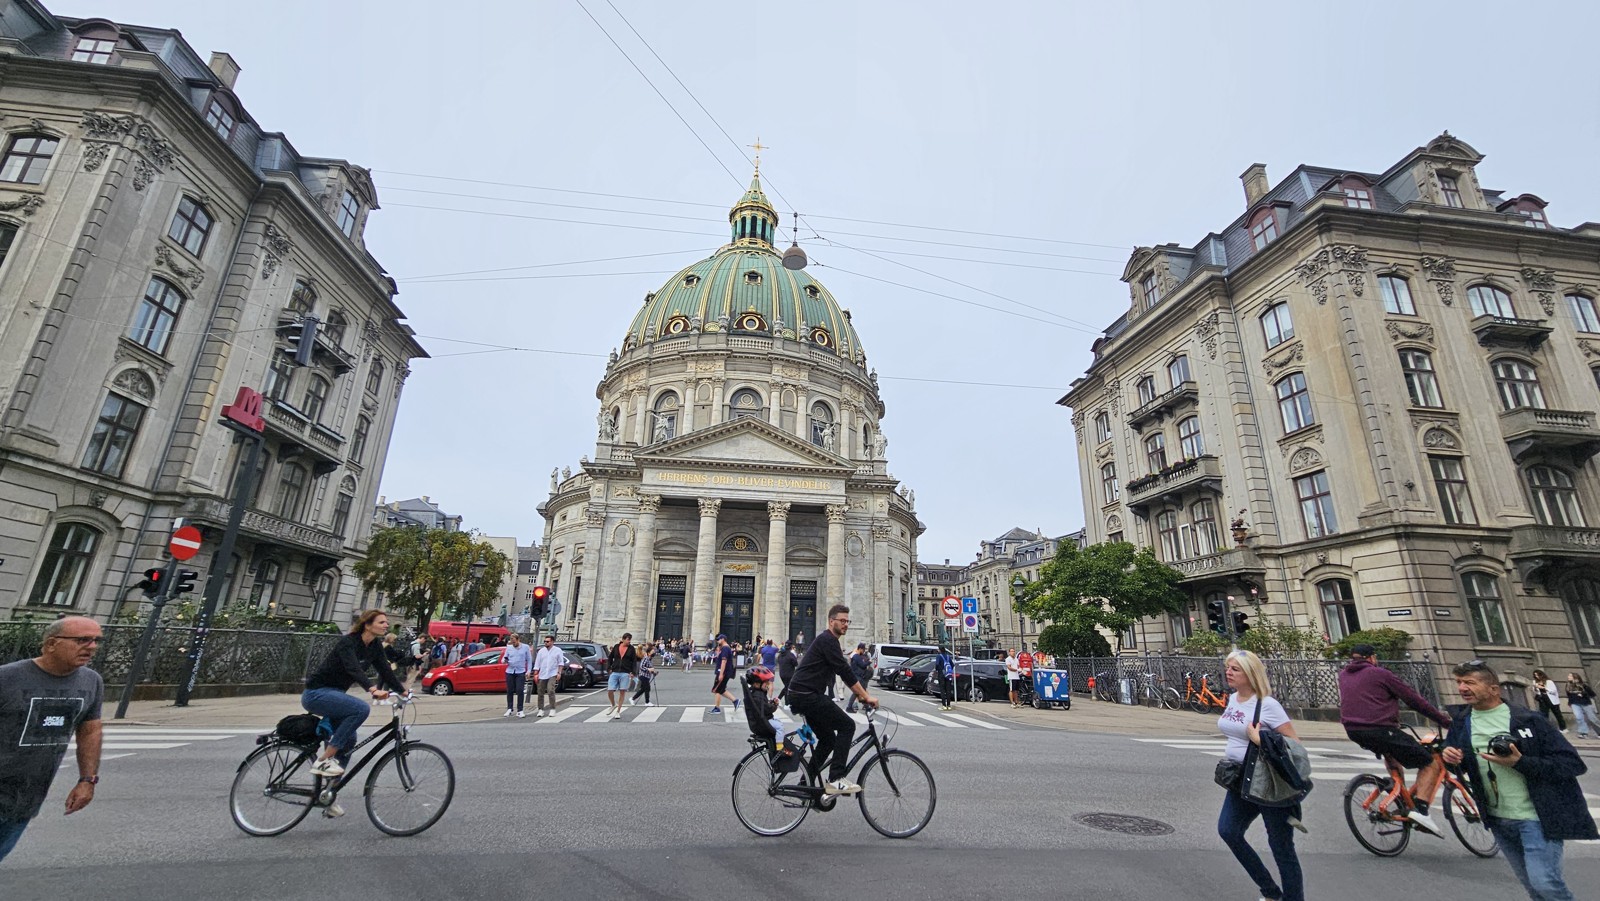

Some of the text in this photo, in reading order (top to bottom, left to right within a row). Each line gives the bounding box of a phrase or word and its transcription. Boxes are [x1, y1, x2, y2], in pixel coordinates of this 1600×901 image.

[221, 387, 265, 432] M
[659, 472, 831, 490] HERRENS ORD BLIVER EVINDELIG
[1517, 727, 1534, 739] H
